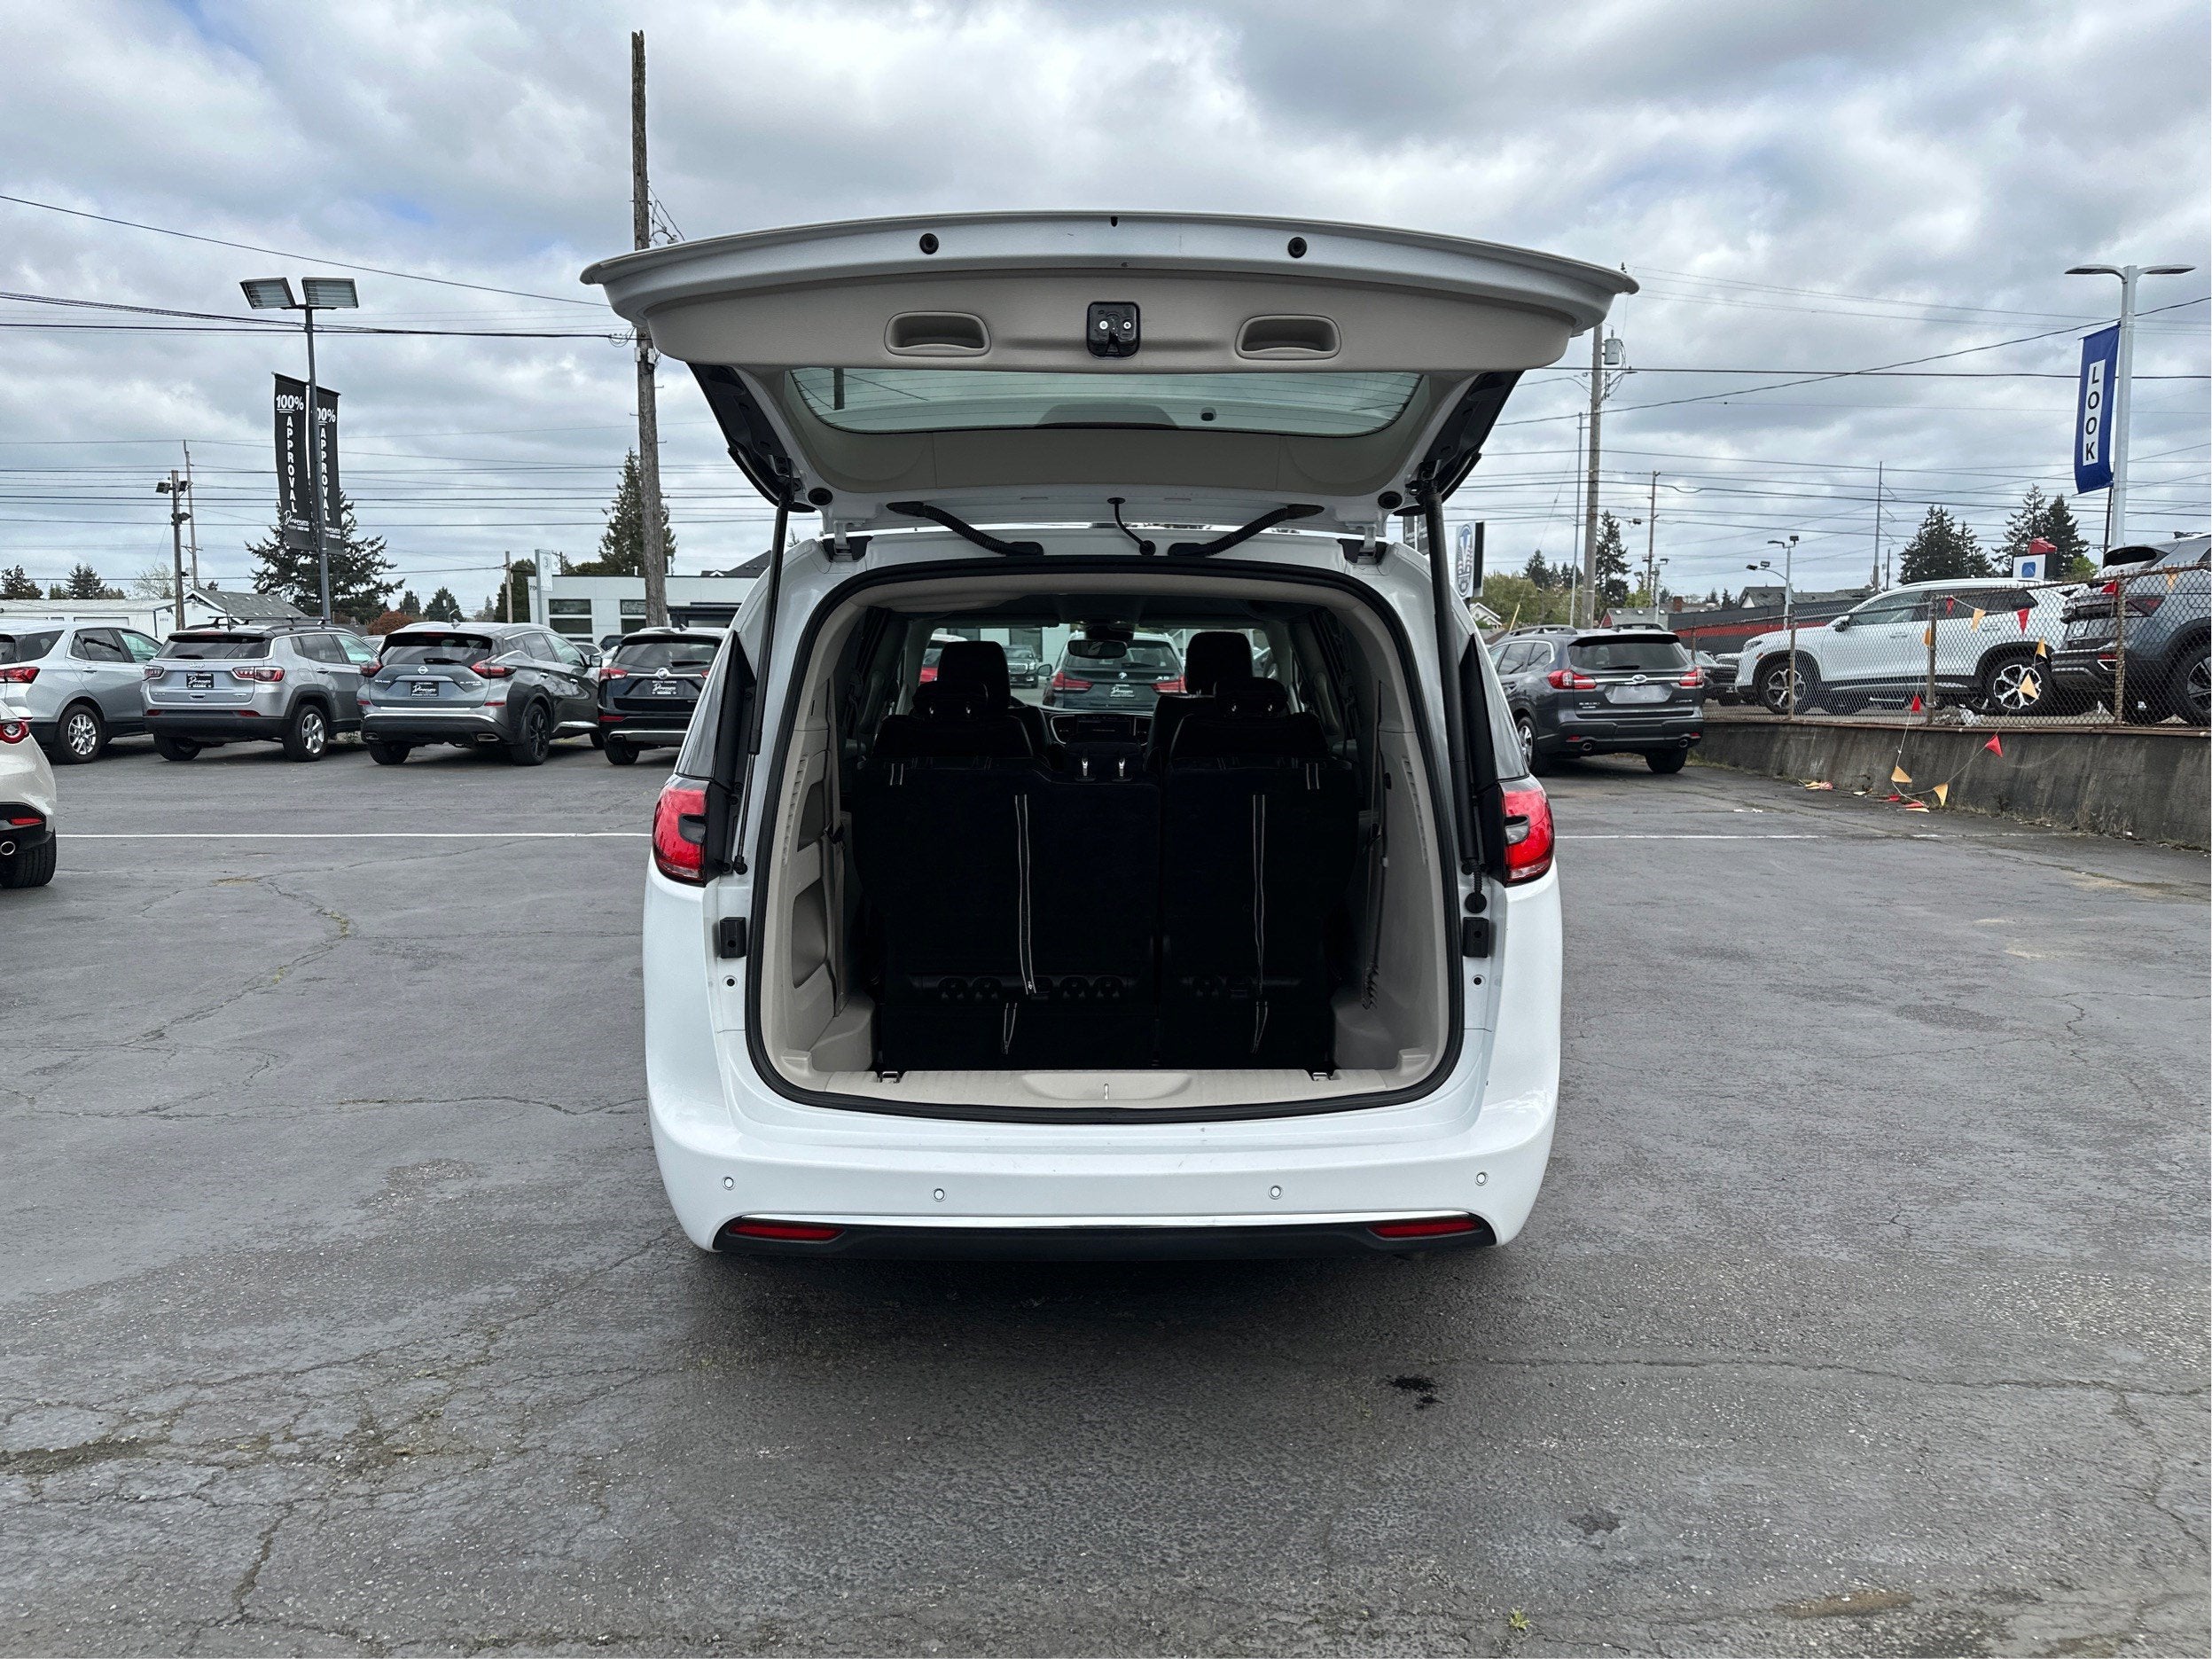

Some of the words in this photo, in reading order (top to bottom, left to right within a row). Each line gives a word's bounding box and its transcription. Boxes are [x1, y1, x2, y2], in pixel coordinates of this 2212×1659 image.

[276, 394, 304, 411] 100%
[317, 407, 336, 423] 00%
[2085, 366, 2100, 461] LOOK
[286, 415, 298, 513] APPROVAL
[320, 427, 331, 521] APPROVAL
